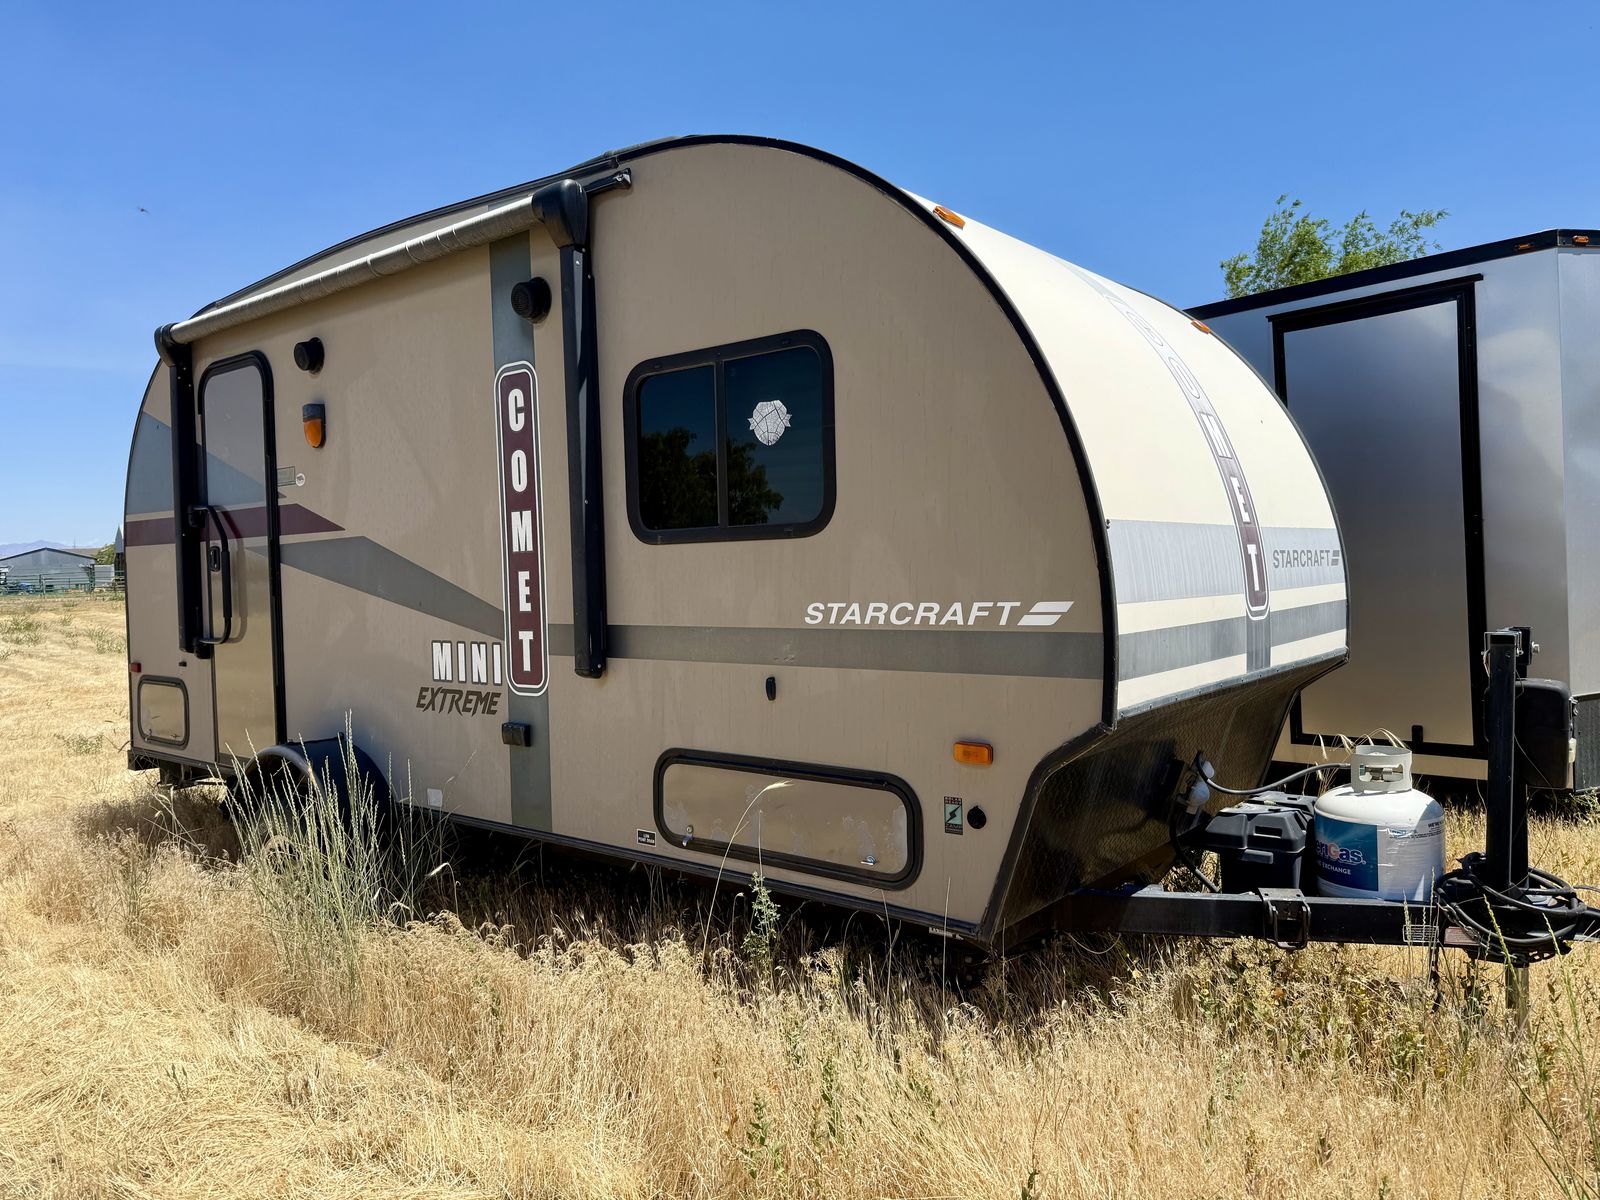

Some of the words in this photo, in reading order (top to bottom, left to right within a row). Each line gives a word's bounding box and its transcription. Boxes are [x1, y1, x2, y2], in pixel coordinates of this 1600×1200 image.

[507, 388, 534, 672] COMET
[1272, 549, 1331, 569] STARCRAFT
[804, 601, 1022, 626] STARCRAFT
[431, 640, 502, 686] MINI
[416, 686, 502, 717] EXTREME
[1322, 862, 1352, 876] EXCHANGE
